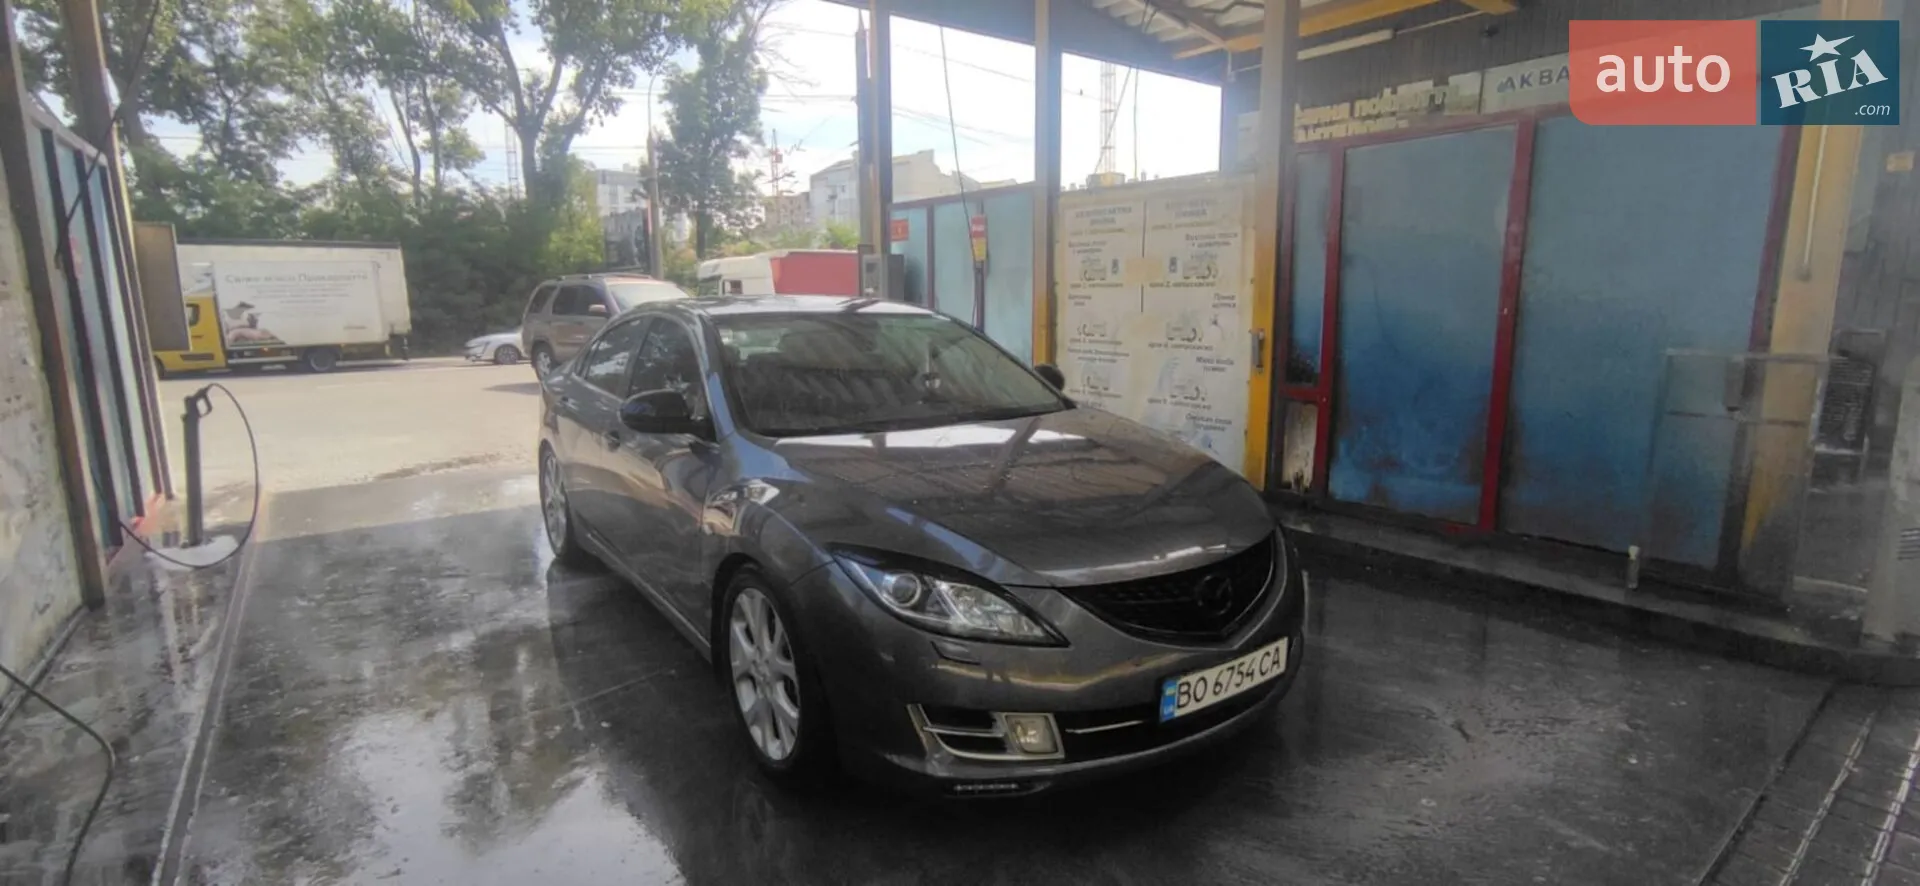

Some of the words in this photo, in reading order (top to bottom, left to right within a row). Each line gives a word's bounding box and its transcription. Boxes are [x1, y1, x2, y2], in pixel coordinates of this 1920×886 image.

[1177, 676, 1208, 709] BO
[1212, 657, 1255, 696] 6754
[1259, 646, 1280, 676] CA
